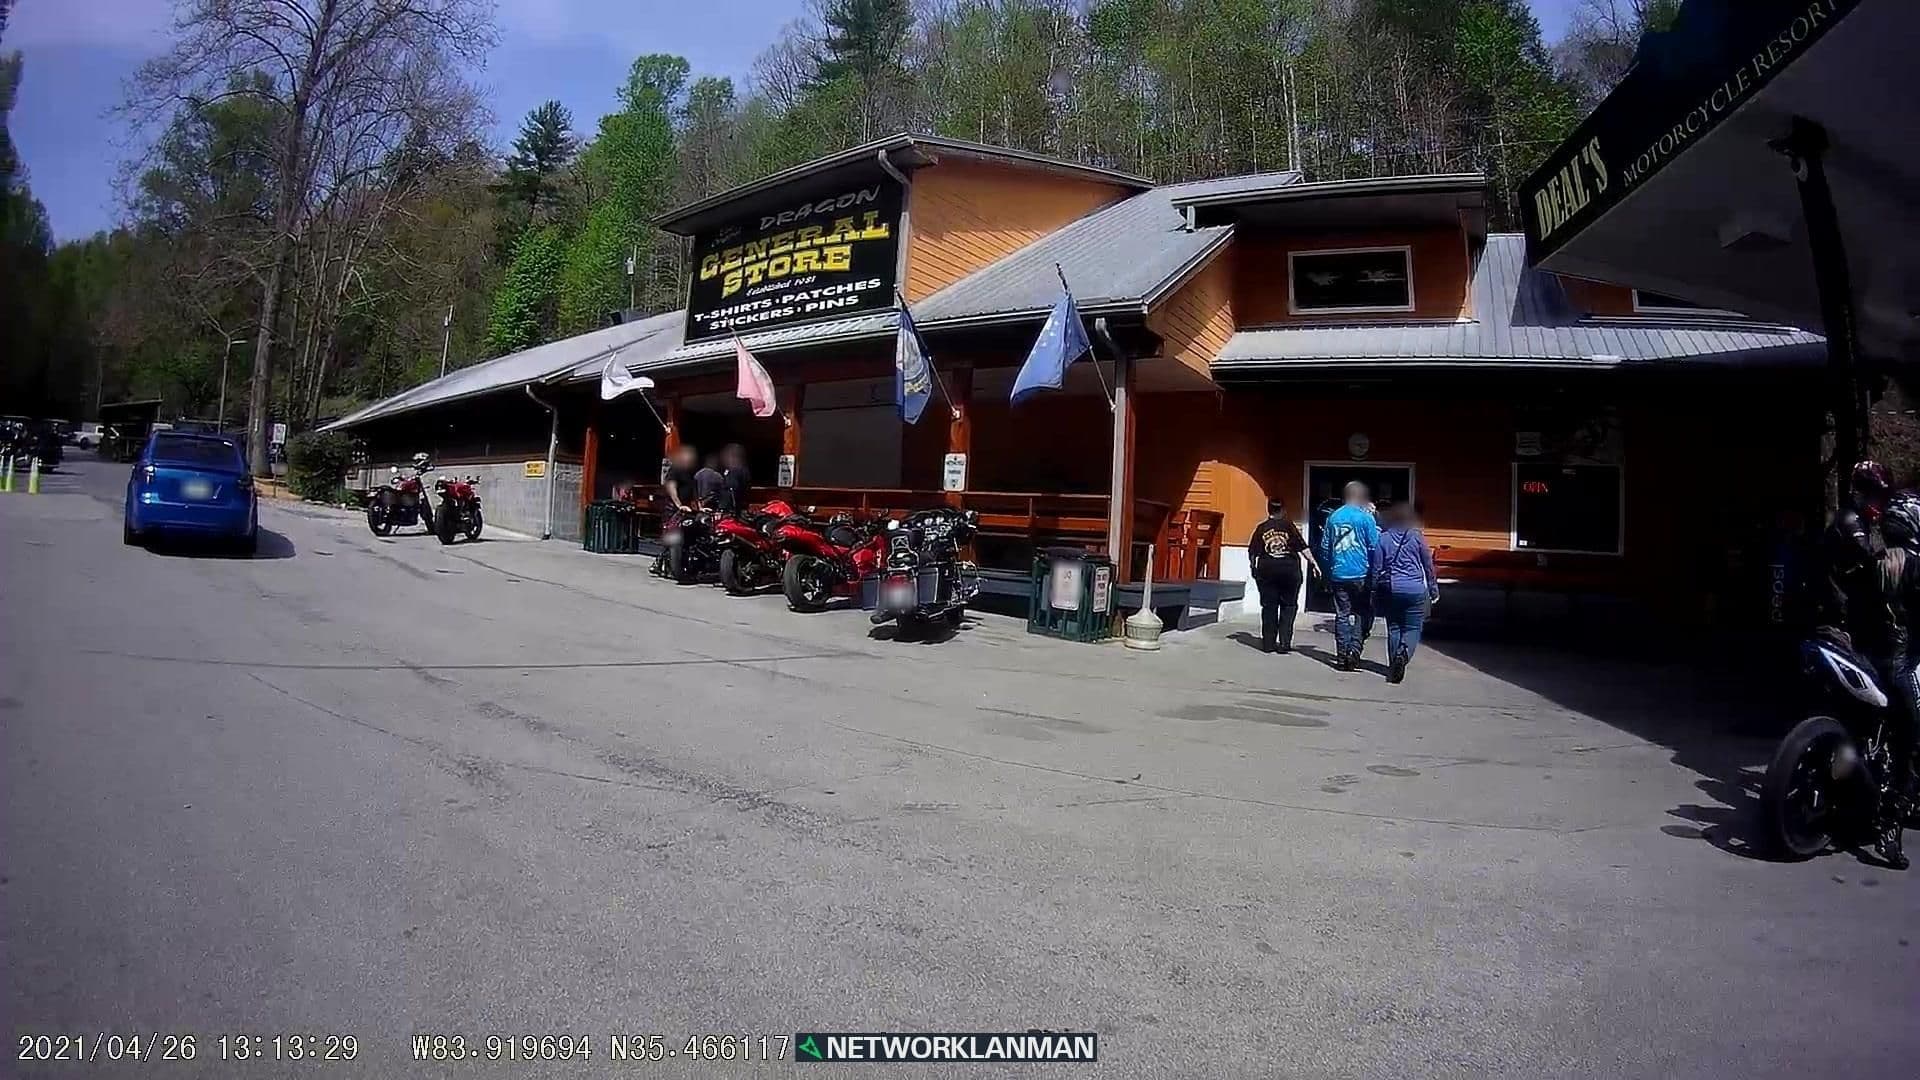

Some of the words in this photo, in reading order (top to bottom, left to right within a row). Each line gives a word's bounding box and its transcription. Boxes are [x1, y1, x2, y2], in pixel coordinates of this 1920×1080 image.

[1534, 136, 1609, 241] DEAL'S
[1623, 67, 1751, 188] MOTORCYCLE
[759, 184, 881, 231] DRAGON
[699, 210, 891, 282] GENERAL
[721, 243, 854, 300] STORE
[694, 298, 773, 323] T-SHIRTS
[781, 278, 882, 305] PATCHES
[709, 306, 796, 331] STICKERS
[805, 295, 860, 313] PINS
